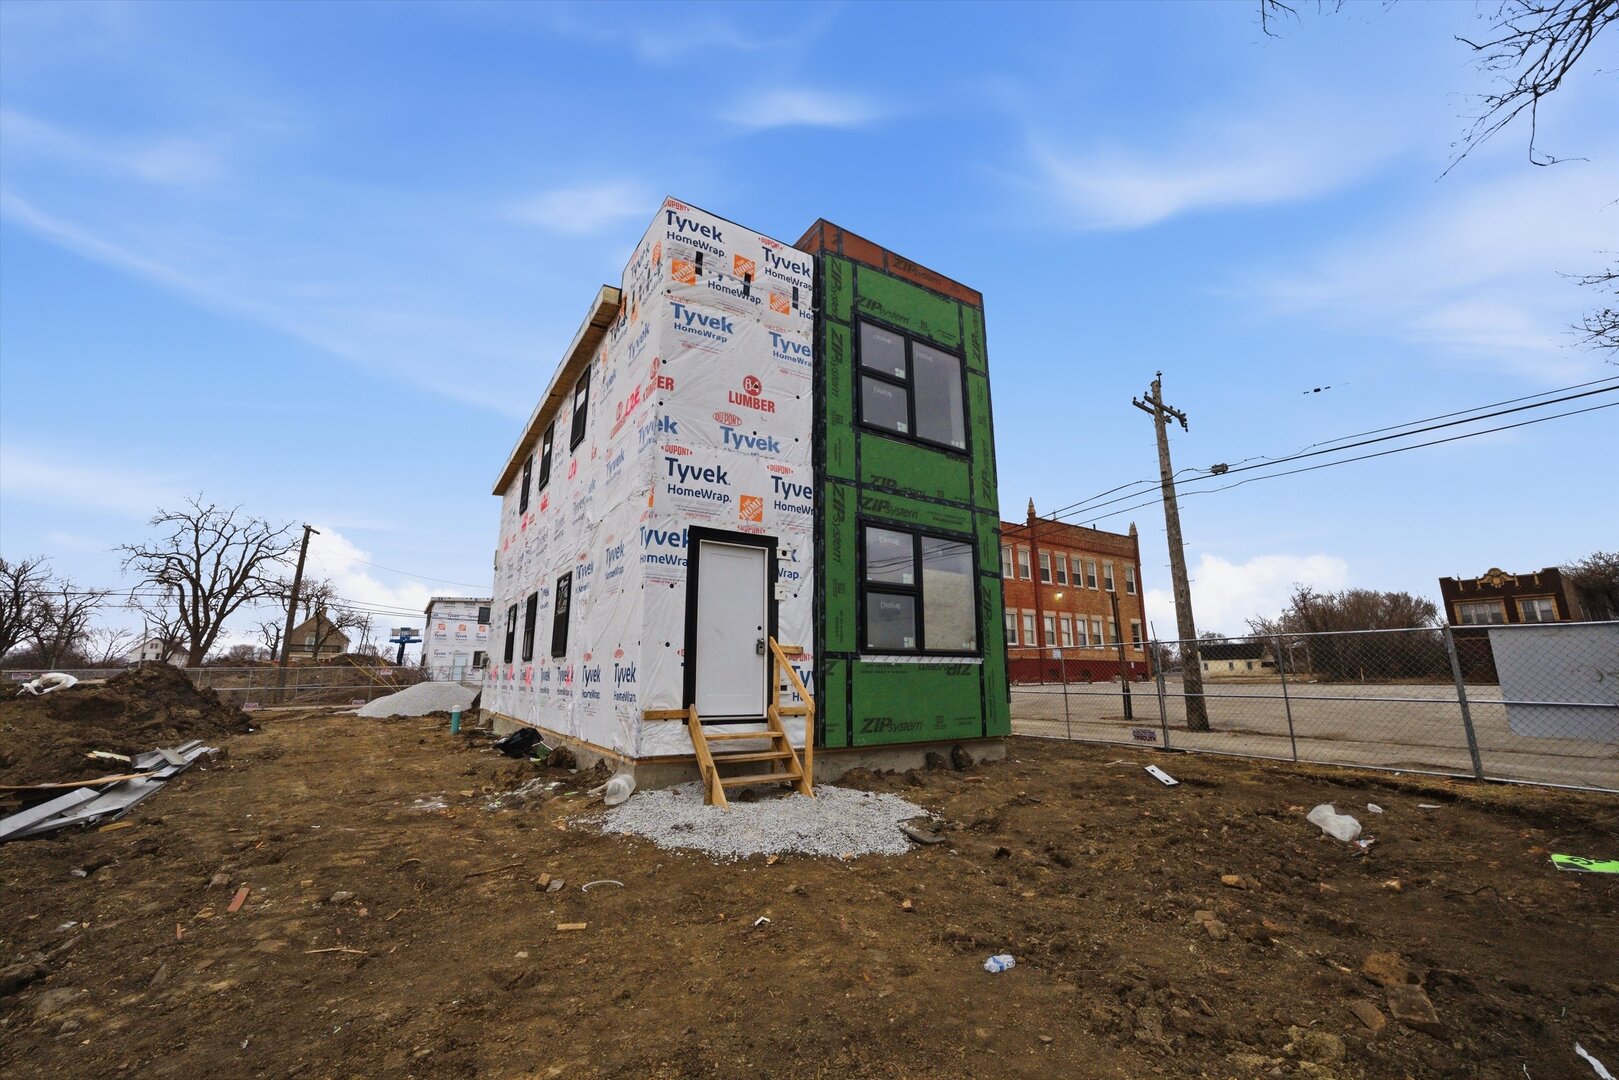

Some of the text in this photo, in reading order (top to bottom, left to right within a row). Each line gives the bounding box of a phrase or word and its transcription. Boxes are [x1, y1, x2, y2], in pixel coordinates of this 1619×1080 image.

[665, 209, 723, 243] Tyvek
[666, 230, 725, 258] HomeWrap
[762, 246, 811, 279] Tyvek
[669, 301, 734, 334] Tyvek
[673, 322, 728, 343] HomeWrap
[768, 331, 812, 357] Tyve
[772, 350, 812, 368] HomeWra
[728, 390, 776, 413] LUMBER
[664, 444, 690, 456] DUPONT
[720, 425, 780, 453] Tyvek
[664, 456, 728, 485] Tyvek
[667, 483, 730, 504] HomeWrap
[770, 475, 813, 500] Tyve
[614, 661, 637, 688] Tyvek
[859, 716, 923, 735] ZIPsystem
